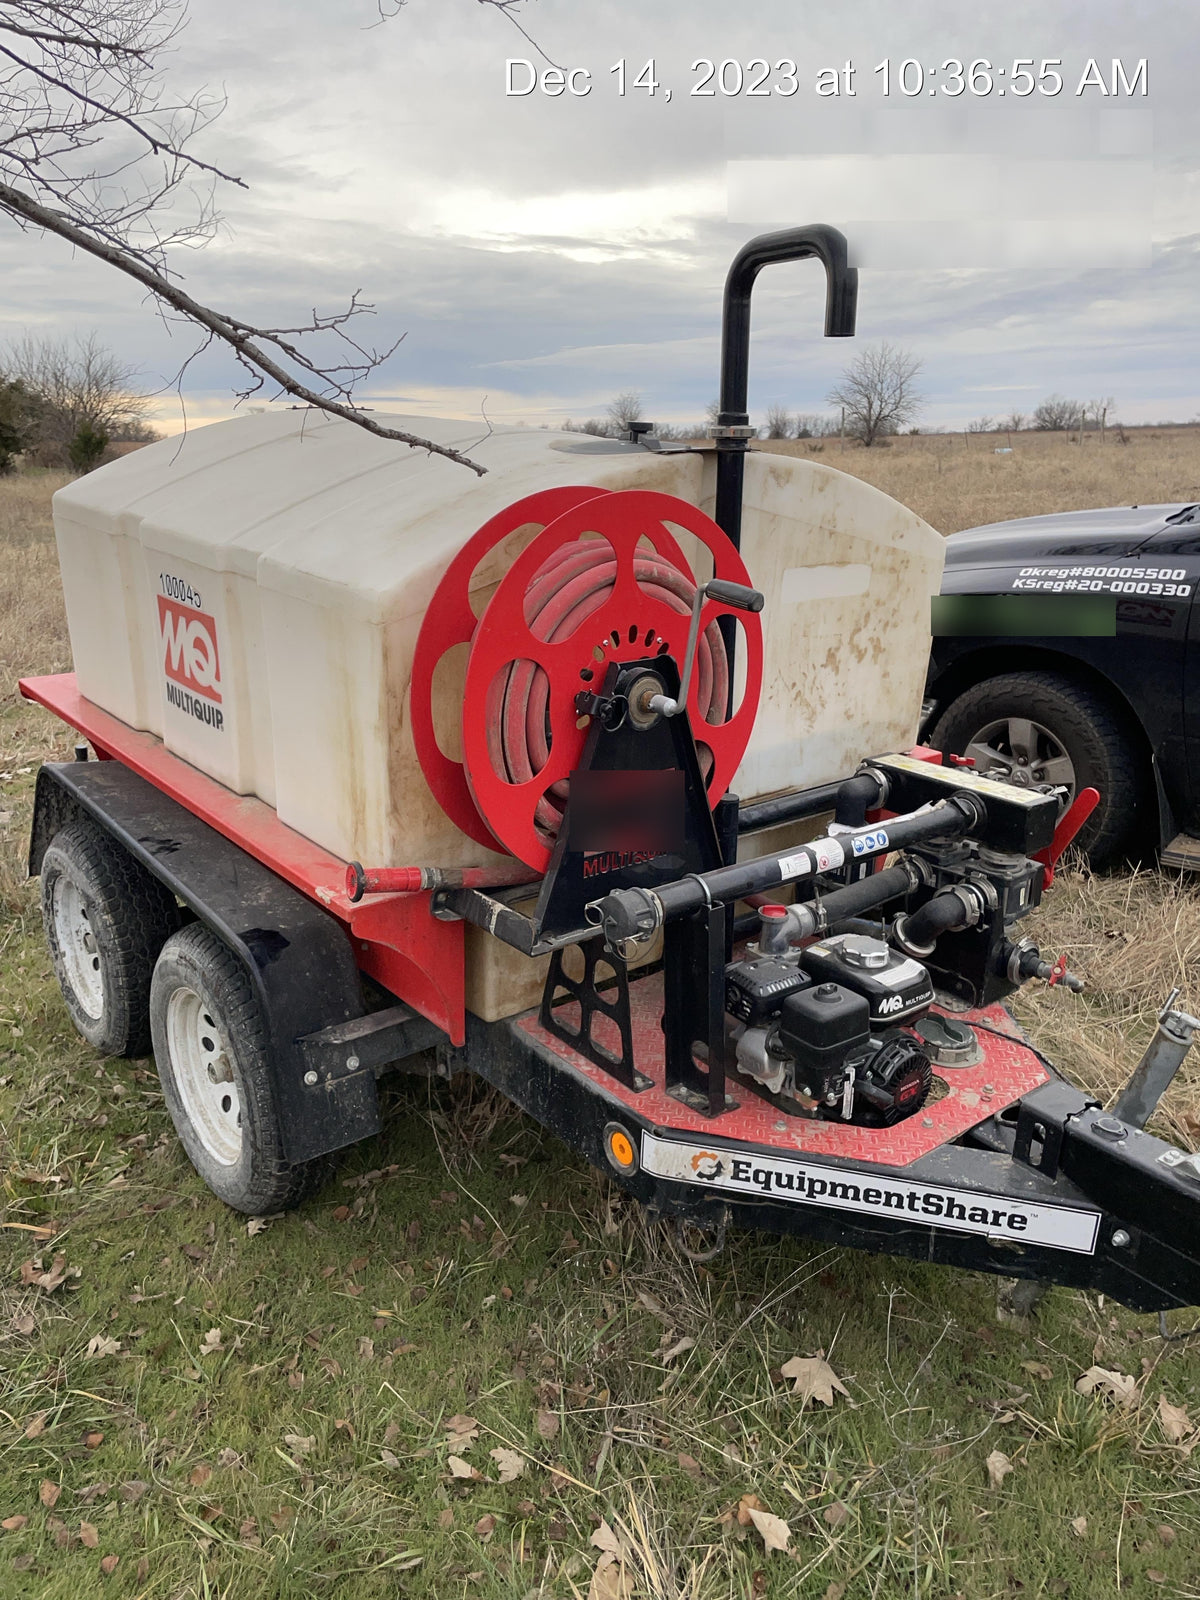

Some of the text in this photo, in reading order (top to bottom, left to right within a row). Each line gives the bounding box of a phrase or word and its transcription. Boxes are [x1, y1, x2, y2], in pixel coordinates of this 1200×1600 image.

[159, 573, 202, 608] 100045
[1012, 579, 1192, 597] KSreg#20-000330
[161, 609, 222, 696] MQ
[166, 682, 222, 730] MULTIQUIP
[878, 995, 904, 1013] MQ
[730, 1159, 1028, 1231] EquipmentShare
